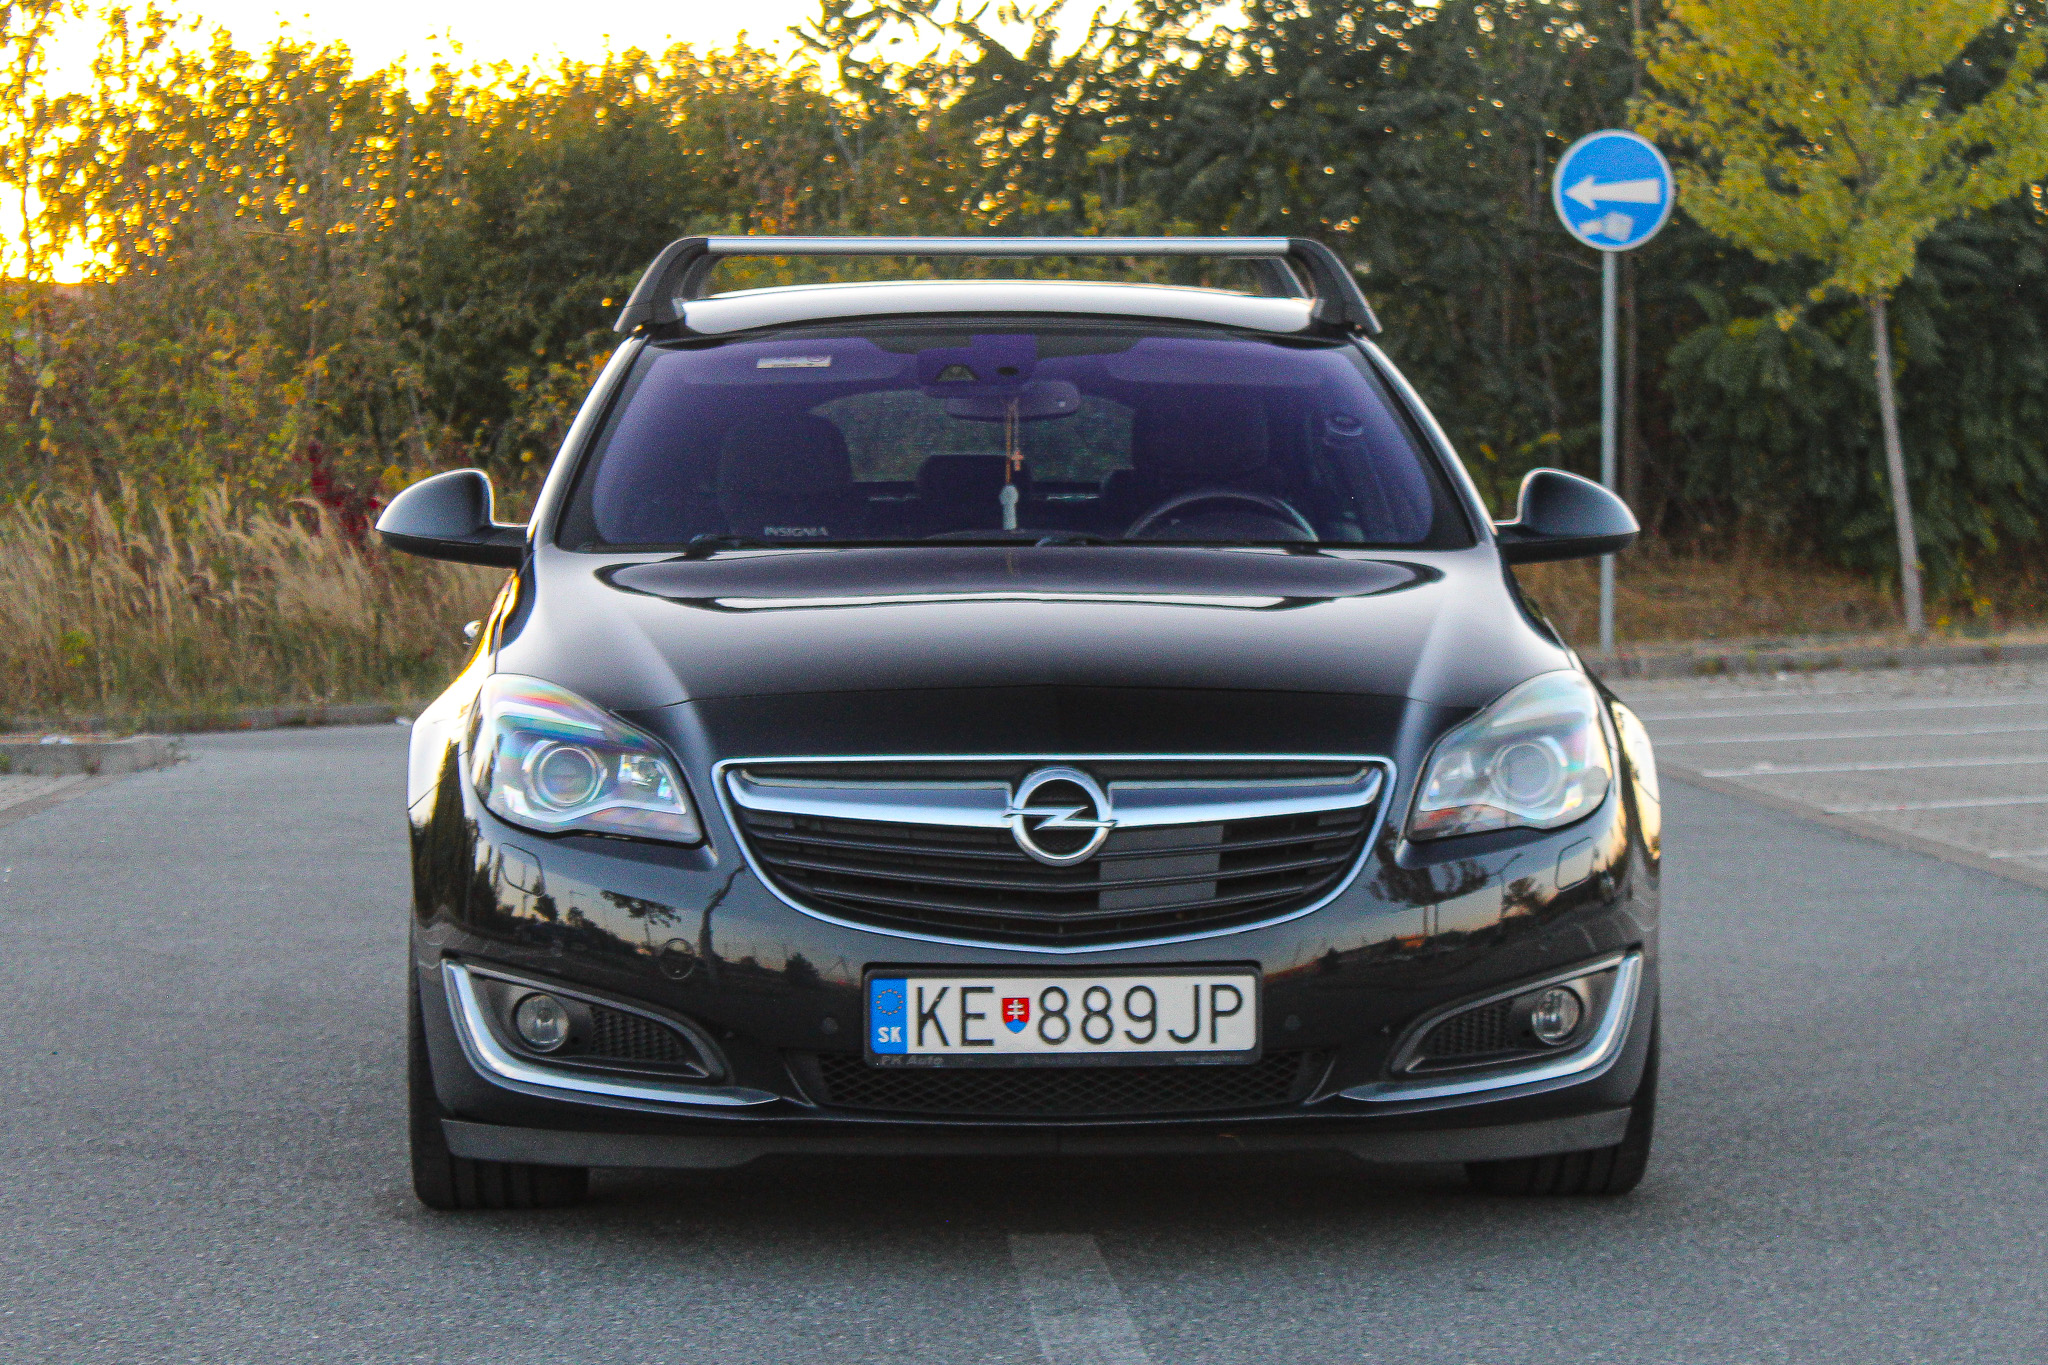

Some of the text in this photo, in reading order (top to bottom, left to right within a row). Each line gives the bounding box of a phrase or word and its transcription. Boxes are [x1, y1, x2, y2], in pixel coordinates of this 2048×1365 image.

[877, 1026, 902, 1043] SK
[916, 984, 1243, 1047] KE 889JP
